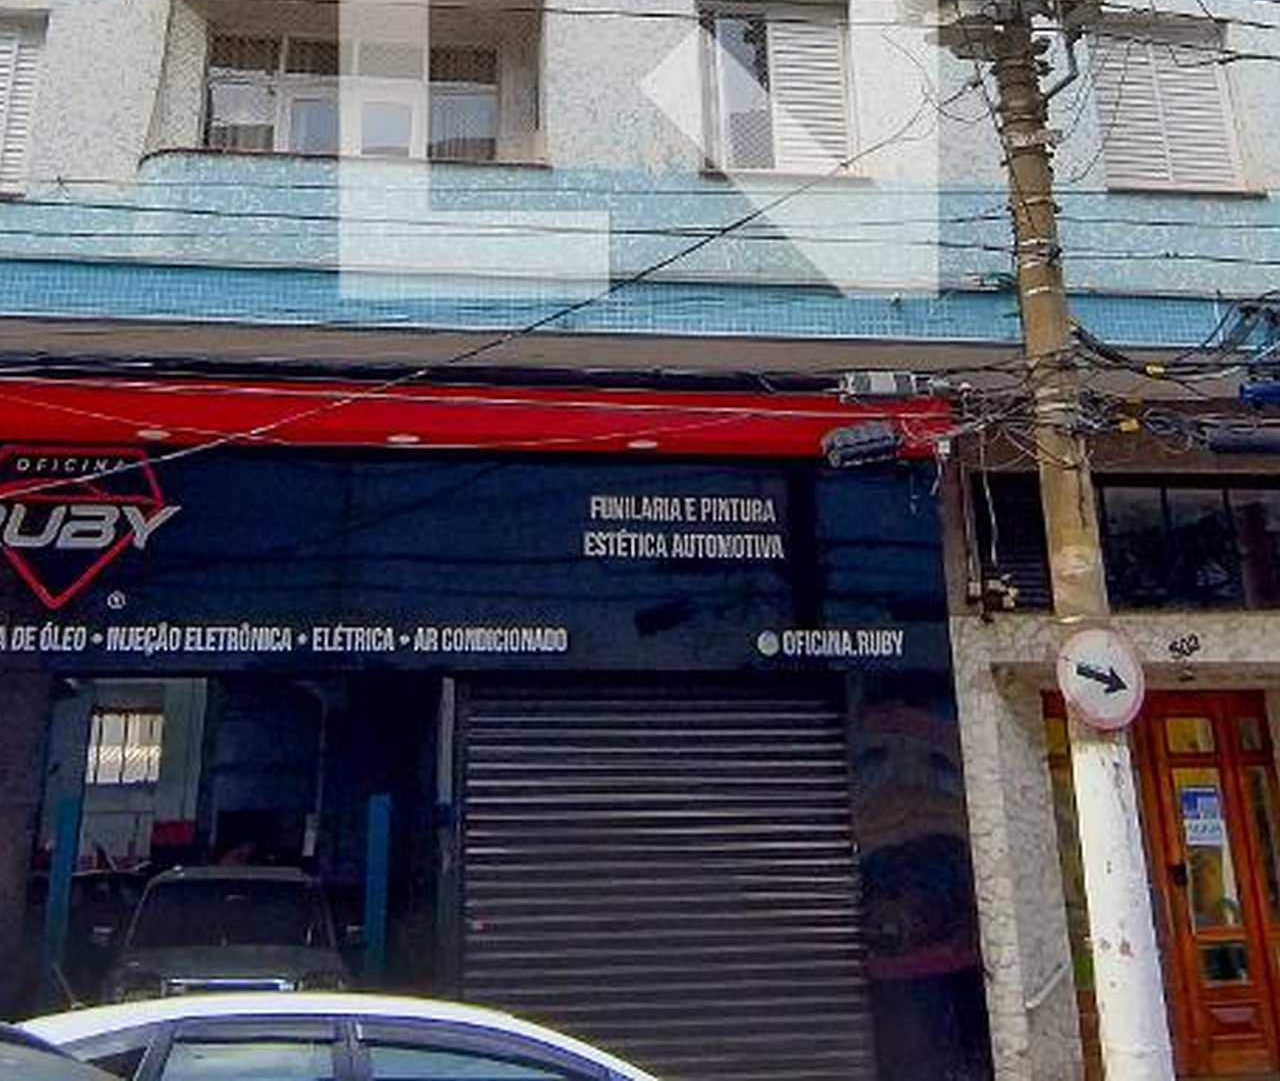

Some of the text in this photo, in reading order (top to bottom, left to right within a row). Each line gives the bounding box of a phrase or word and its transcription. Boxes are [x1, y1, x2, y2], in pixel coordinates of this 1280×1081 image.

[16, 458, 125, 472] OFICINA
[591, 496, 776, 522] FUNILARIA E PINTURA
[584, 529, 785, 559] ESTÉTICA AUTOMOTIVA
[11, 626, 37, 651] DE
[39, 622, 86, 651] ÓLEO
[107, 622, 181, 656] INJEÇÃO
[184, 622, 292, 652] ELETRÔNICA
[313, 624, 394, 651] ELÉTRICA
[414, 627, 438, 651] AR
[442, 627, 568, 652] CONDICIONADO
[782, 630, 903, 656] OFICINA.RUBY
